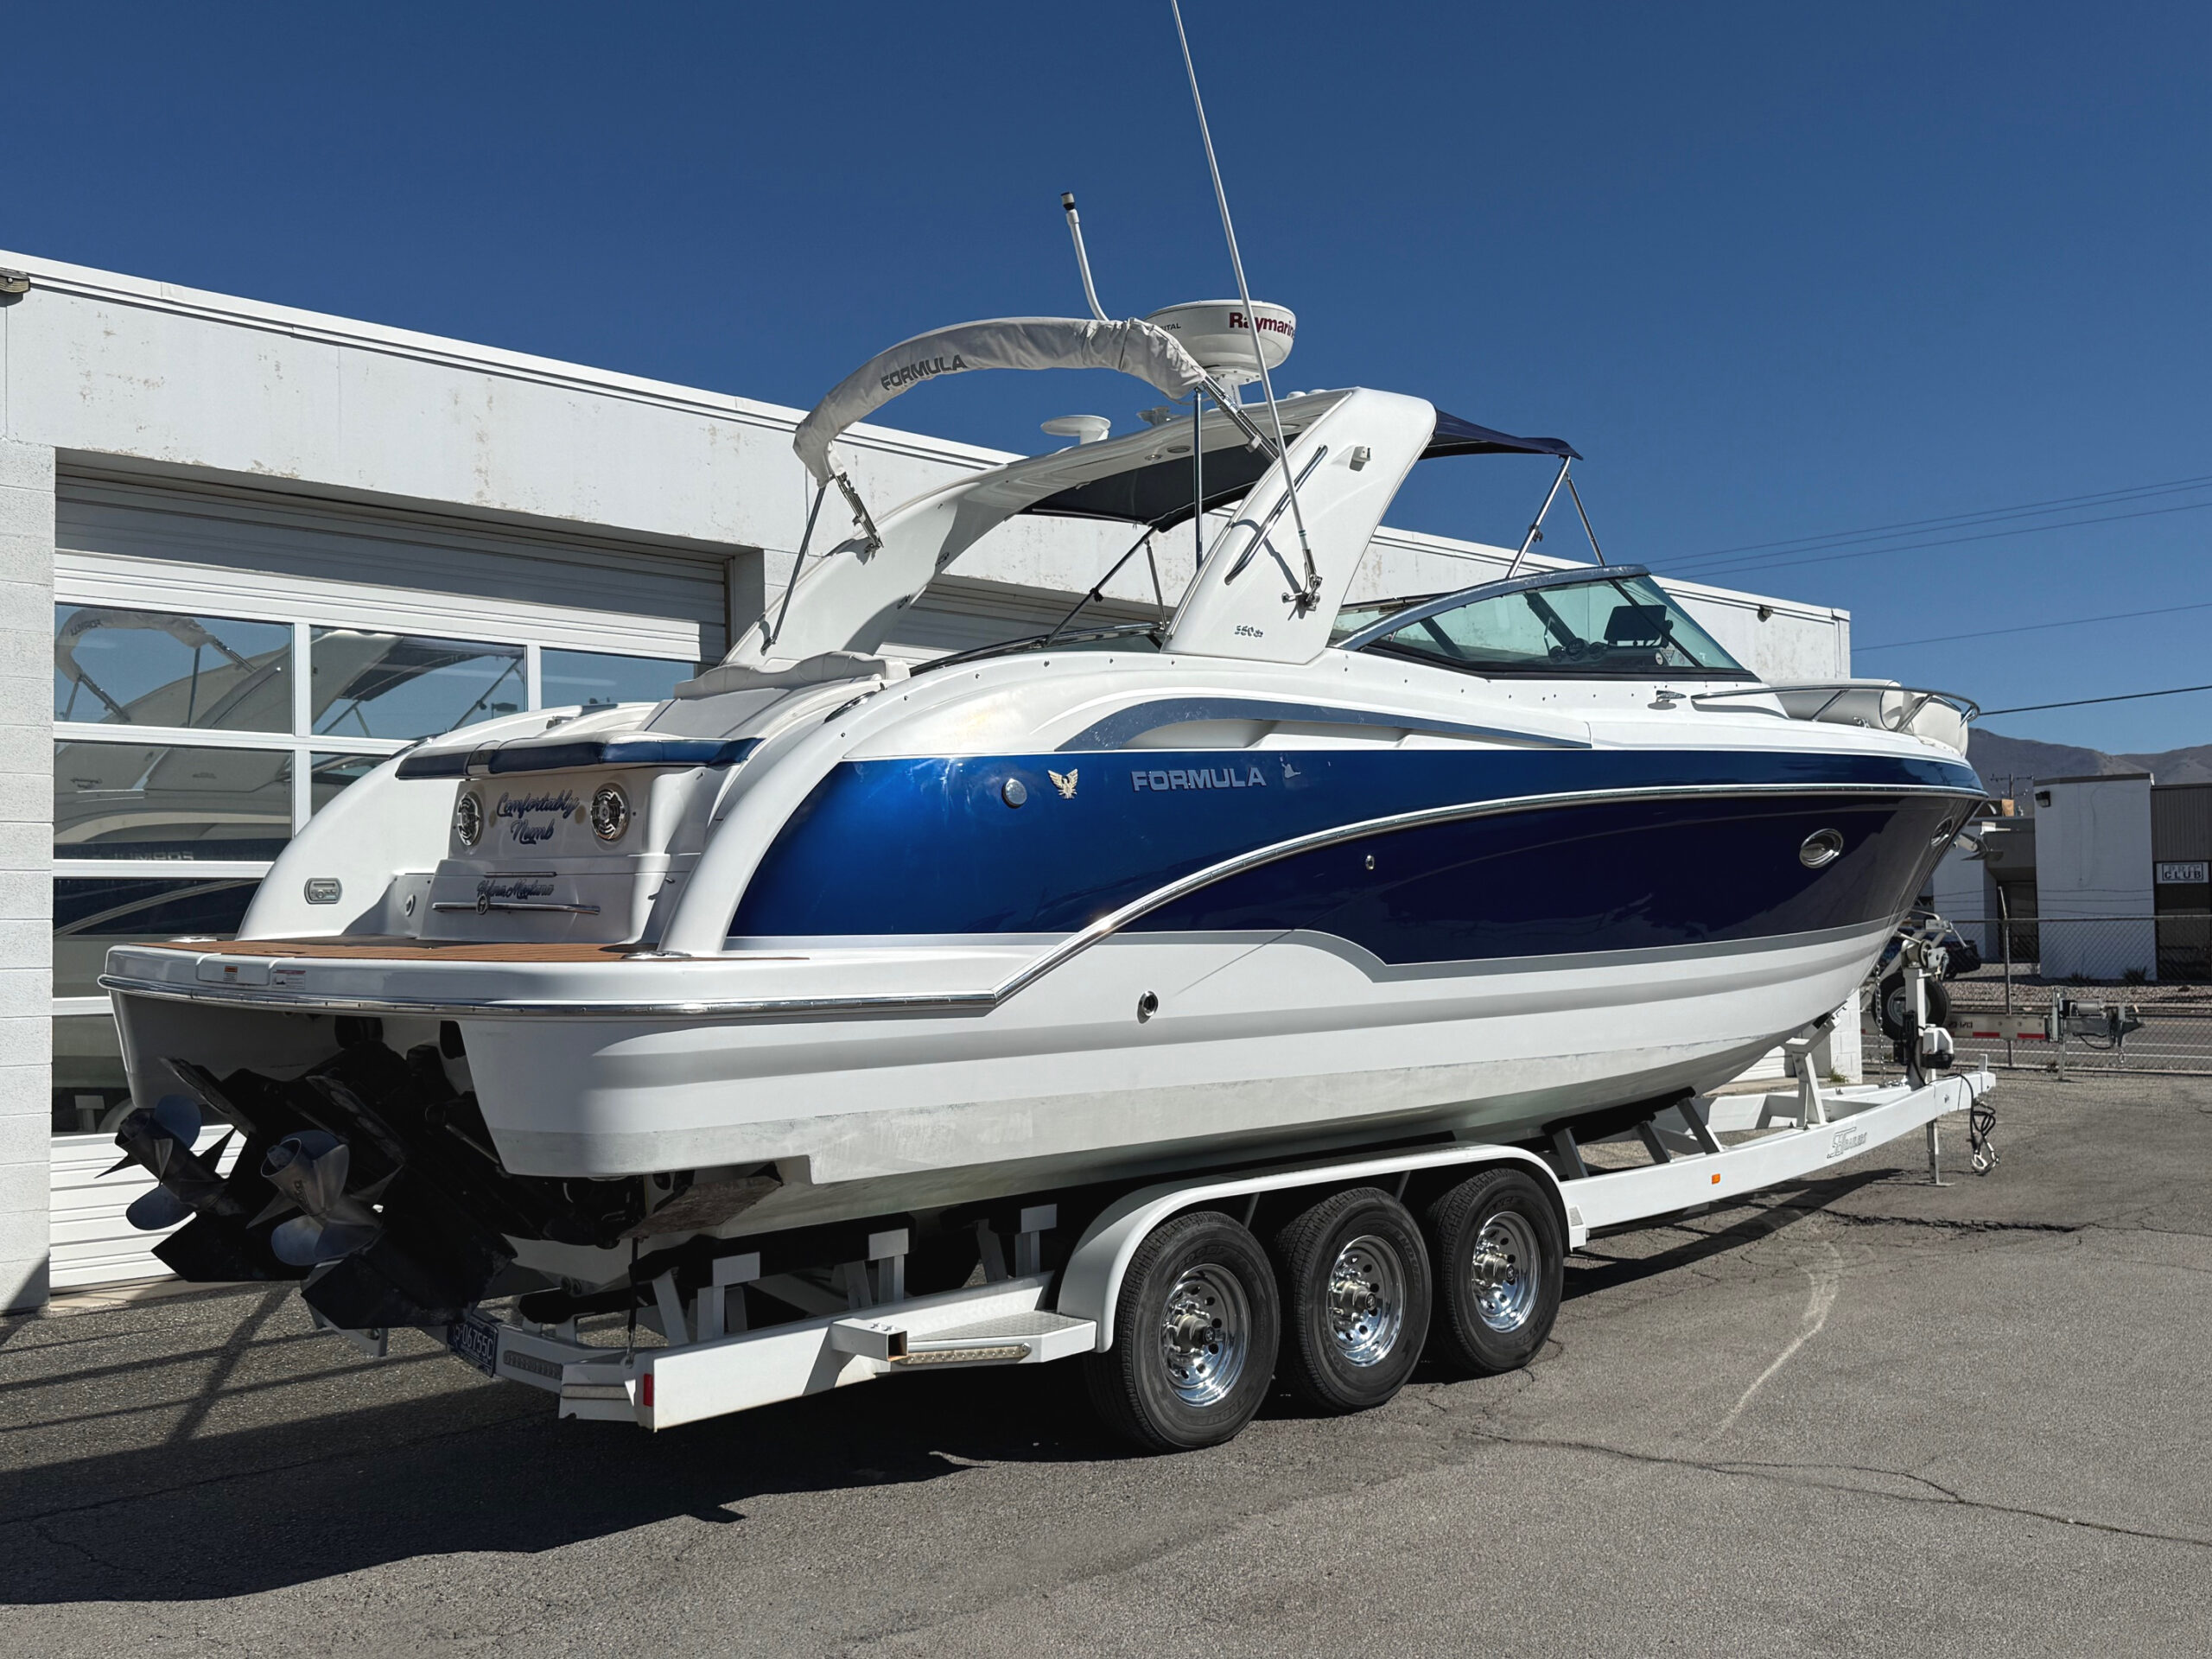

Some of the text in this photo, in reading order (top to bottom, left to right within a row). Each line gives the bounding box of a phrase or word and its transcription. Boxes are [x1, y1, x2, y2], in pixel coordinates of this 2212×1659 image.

[880, 354, 969, 391] FORMULA
[1131, 766, 1267, 791] FORMULA
[497, 790, 580, 819] Comfortably
[511, 818, 555, 845] Numb
[2164, 870, 2202, 879] CLUB
